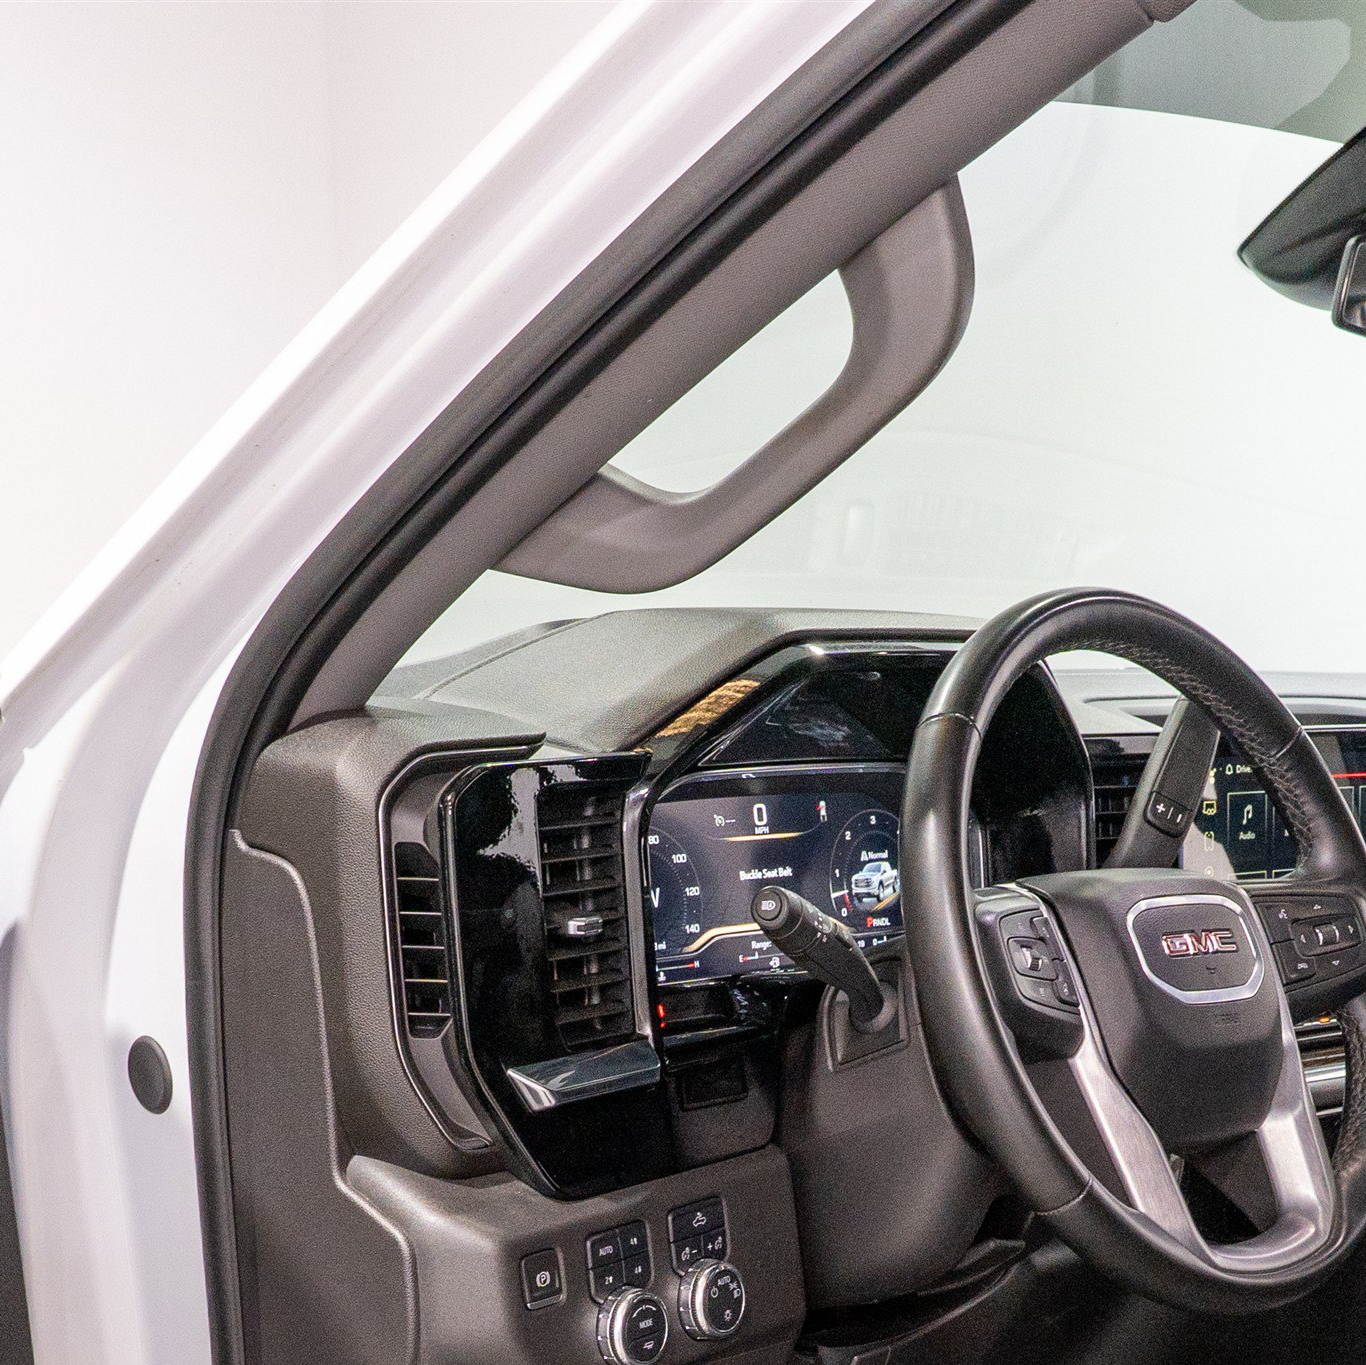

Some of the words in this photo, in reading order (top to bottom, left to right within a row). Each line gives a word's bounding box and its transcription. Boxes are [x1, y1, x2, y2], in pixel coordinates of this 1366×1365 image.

[752, 803, 768, 826] 0
[869, 815, 876, 825] 3
[754, 826, 769, 834] MPH
[647, 835, 660, 845] 80
[845, 831, 852, 841] 2
[1239, 831, 1256, 840] Audio
[671, 853, 688, 864] 100
[739, 870, 763, 881] Buckle
[762, 868, 779, 879] Seat
[778, 866, 793, 878] Belt
[835, 869, 840, 878] 1
[685, 886, 701, 896] 120
[841, 907, 848, 917] 0
[685, 923, 700, 934] 140
[1162, 930, 1237, 957] GMC
[598, 1245, 614, 1257] AUTO
[717, 1275, 731, 1286] AUTO
[639, 1318, 653, 1329] MODE
